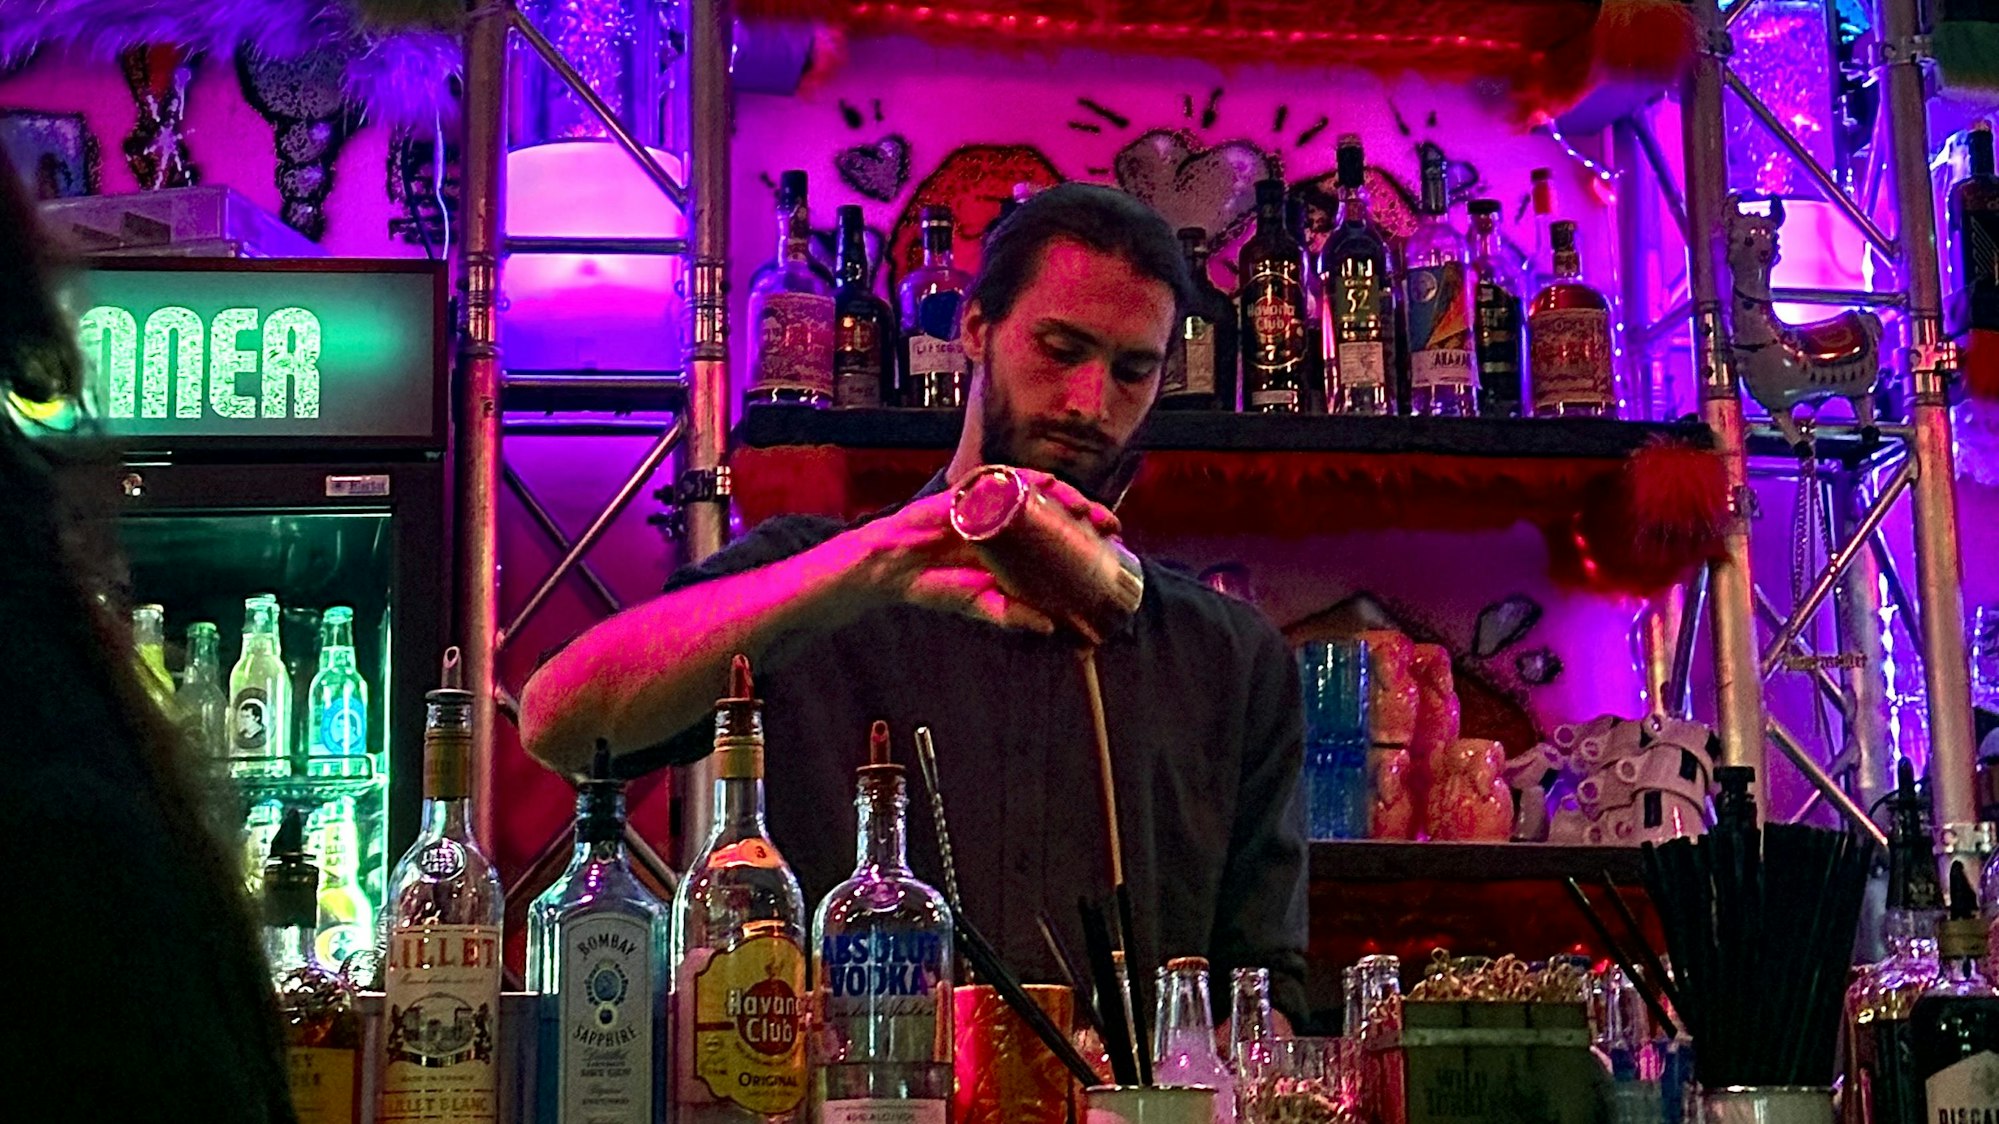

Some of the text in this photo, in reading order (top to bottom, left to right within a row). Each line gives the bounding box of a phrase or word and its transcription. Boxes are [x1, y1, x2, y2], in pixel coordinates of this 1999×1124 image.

[1247, 305, 1296, 318] Havana
[1256, 317, 1285, 332] Club
[1265, 345, 1275, 361] 7
[755, 845, 767, 859] 3
[577, 933, 637, 956] BOMBAY
[823, 932, 940, 965] ABSOLUT
[830, 963, 929, 998] VODKA
[573, 1023, 639, 1047] SAPPHIRE
[745, 1017, 793, 1043] Club
[738, 1071, 799, 1088] ORIGINAL
